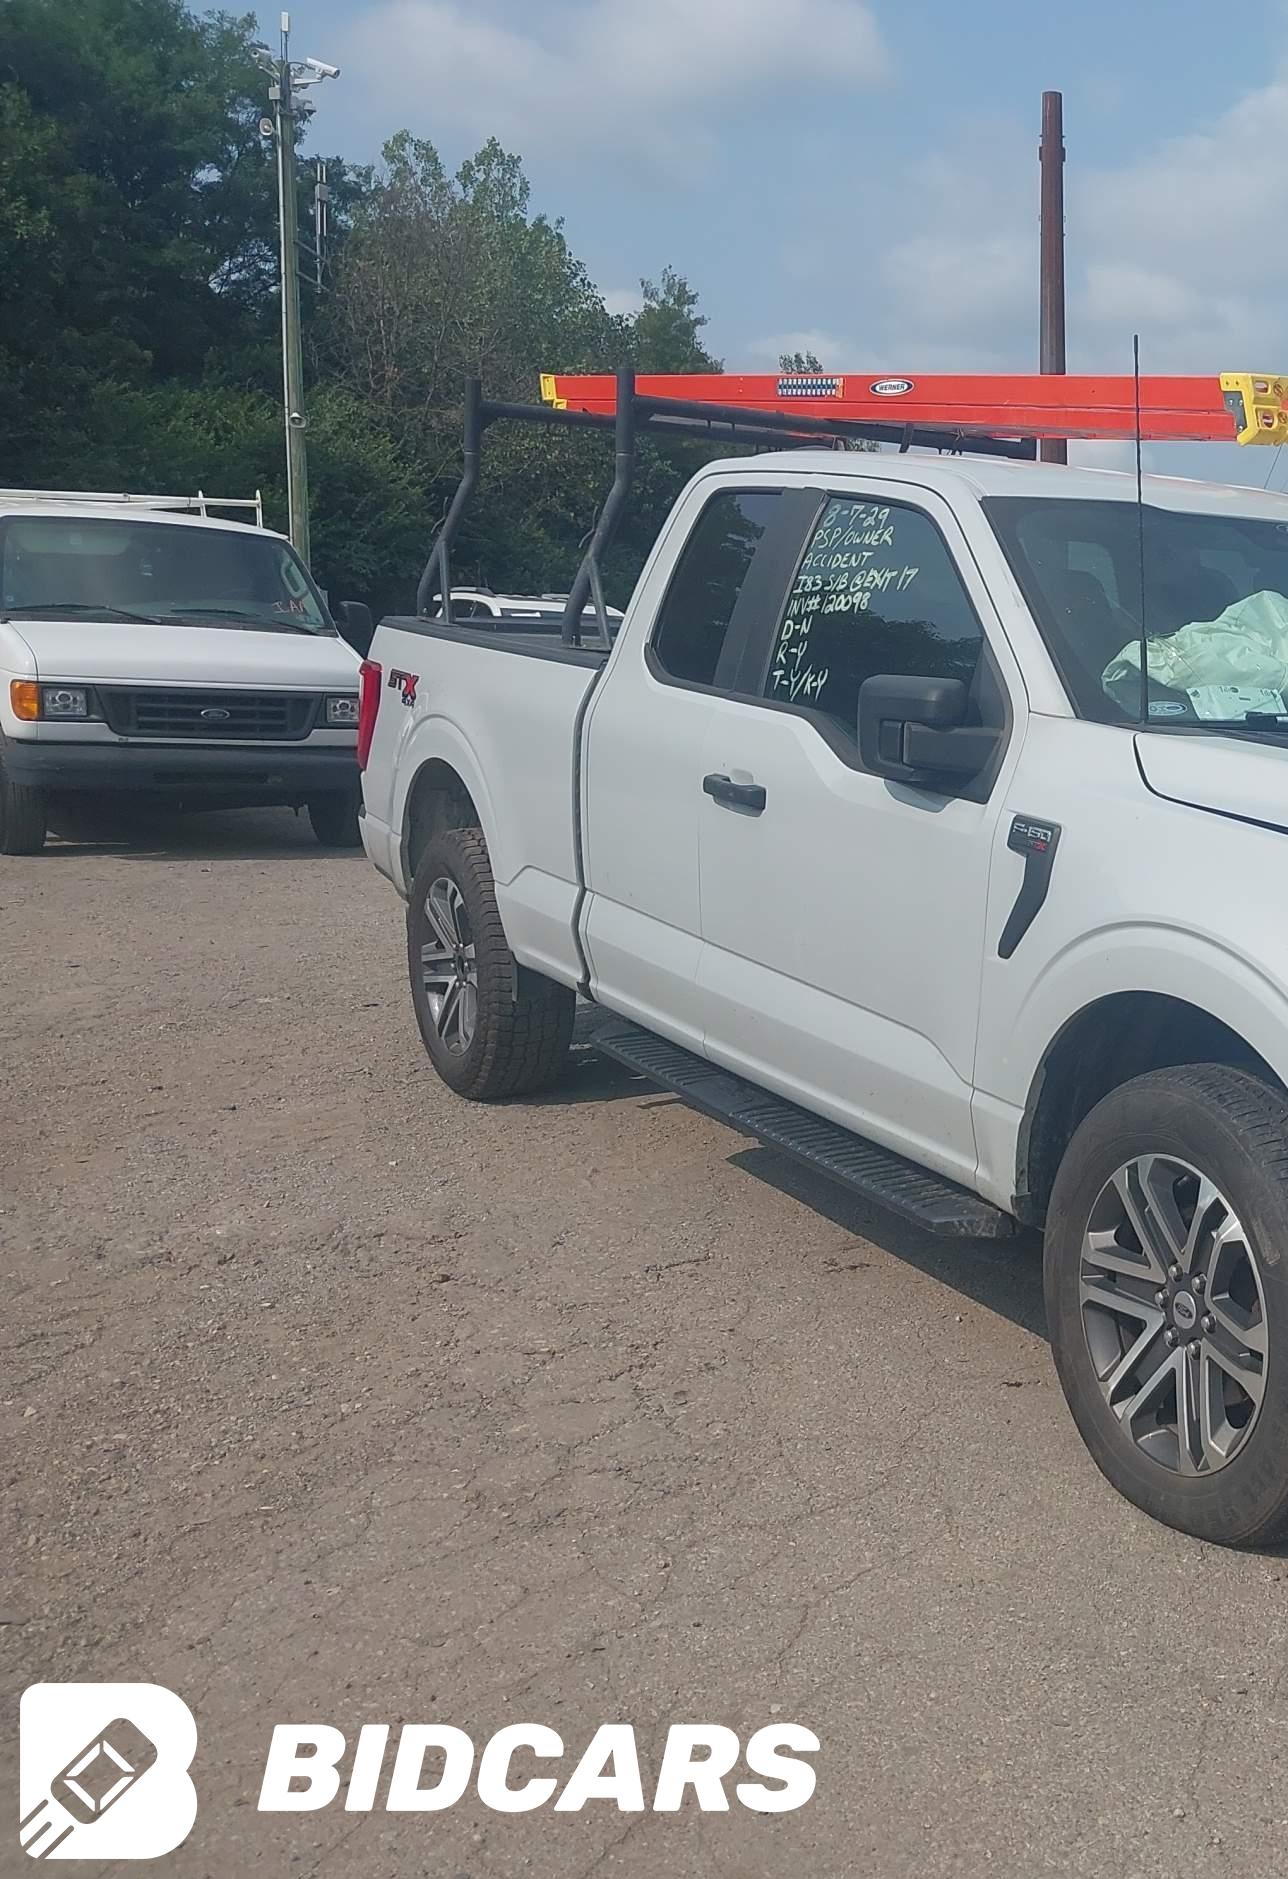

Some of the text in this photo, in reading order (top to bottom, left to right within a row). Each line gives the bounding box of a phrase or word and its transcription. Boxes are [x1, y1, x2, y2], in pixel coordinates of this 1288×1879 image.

[878, 383, 906, 391] WERNER
[800, 551, 874, 570] ACCIDENT
[387, 668, 420, 701] STX
[1012, 822, 1052, 843] F-150
